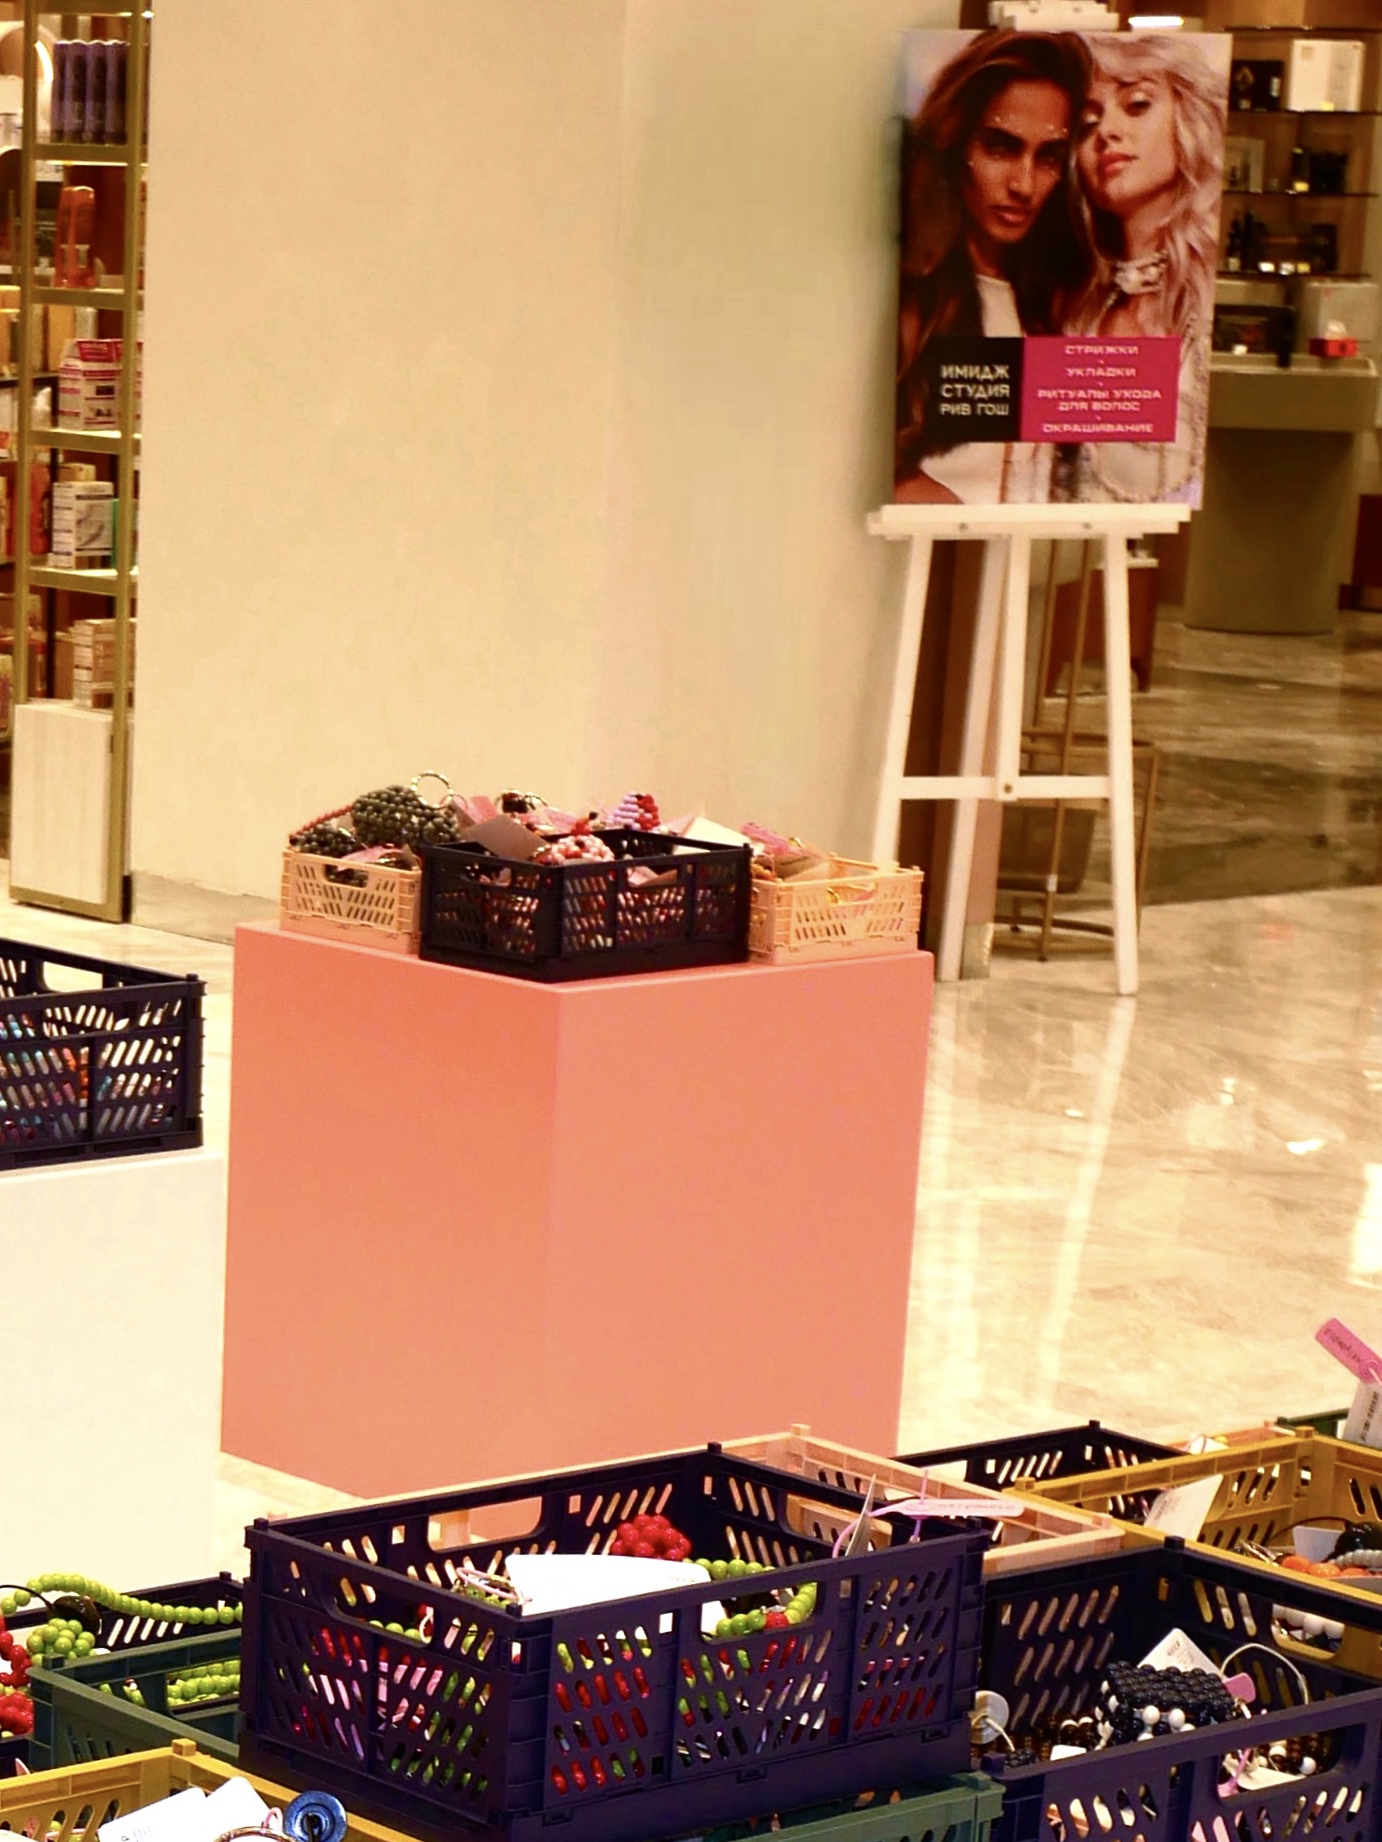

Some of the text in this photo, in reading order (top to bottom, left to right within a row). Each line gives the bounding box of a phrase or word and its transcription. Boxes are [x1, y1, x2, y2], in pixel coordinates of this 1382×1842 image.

[1064, 345, 1139, 355] СТРИЖКИ
[939, 364, 1010, 380] ИМИДЖ
[1066, 367, 1136, 377] УКЛАДКИ
[939, 383, 1010, 399] СТУДИЯ
[1037, 389, 1162, 399] РИТУАЛЫ УХОДА
[939, 403, 1010, 416] РИВ ГОШ
[1057, 402, 1141, 411] ДЛЯ ВОЛОС
[1041, 423, 1154, 434] ОКРАШИВАНИЕ
